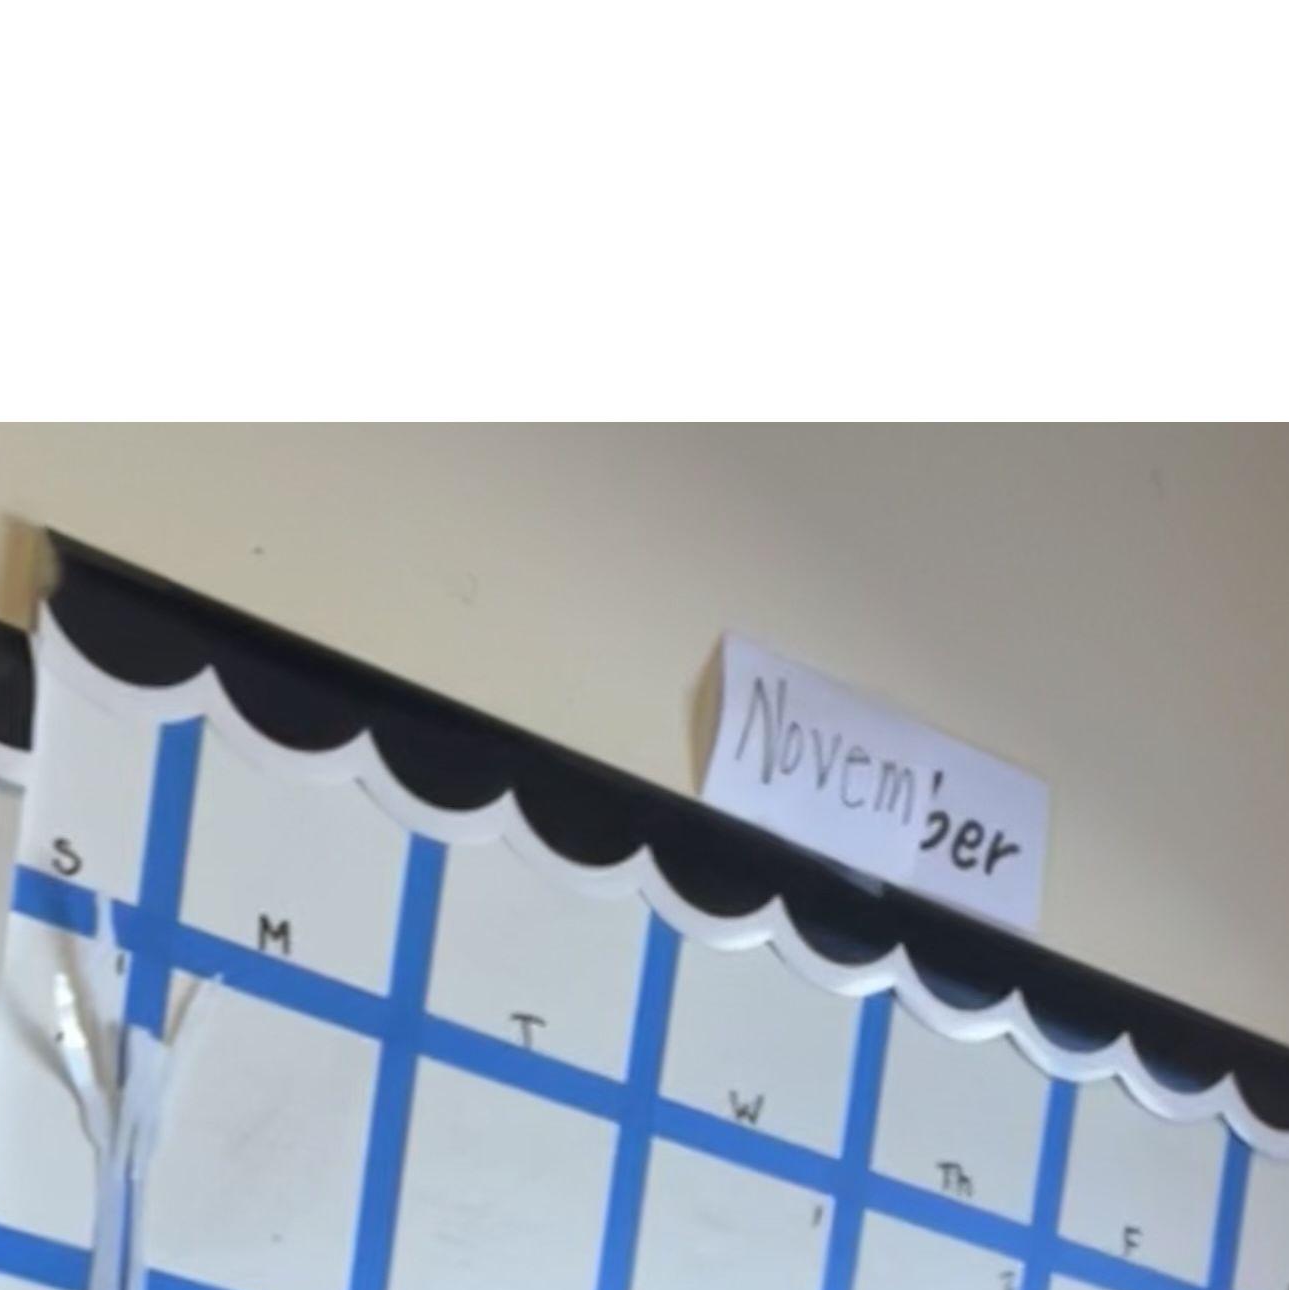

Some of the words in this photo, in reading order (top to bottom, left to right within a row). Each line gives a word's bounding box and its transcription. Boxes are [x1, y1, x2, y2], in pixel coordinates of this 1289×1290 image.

[51, 837, 84, 878] S
[257, 914, 293, 956] M
[510, 1012, 547, 1051] T
[729, 1089, 766, 1126] W
[936, 1160, 976, 1200] Th
[1122, 1225, 1143, 1257] F
